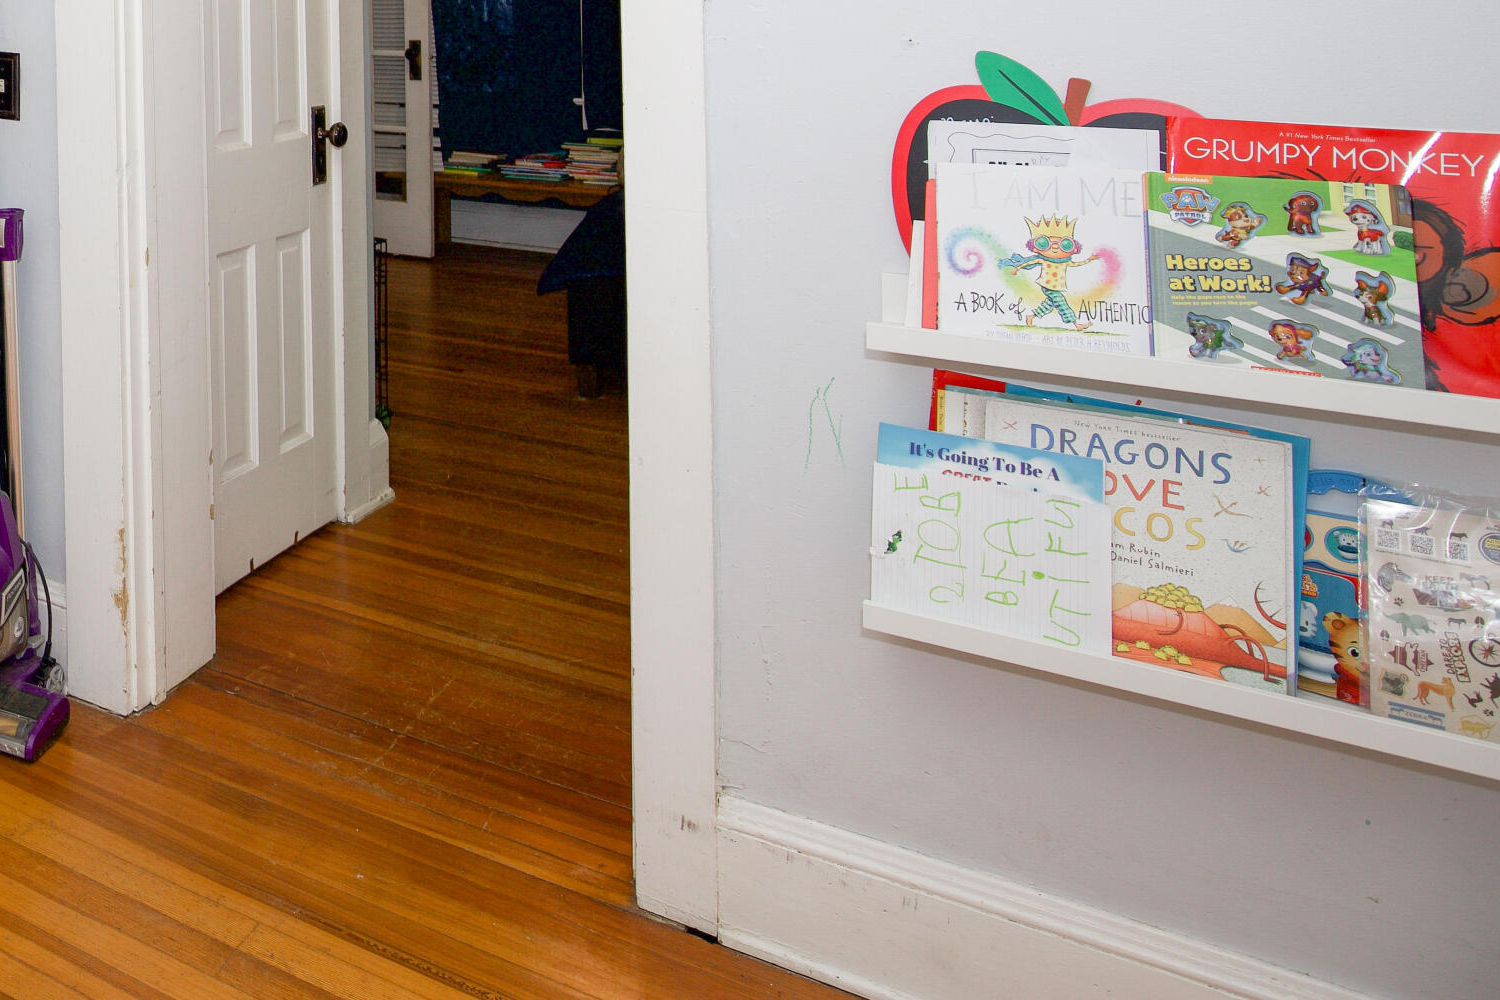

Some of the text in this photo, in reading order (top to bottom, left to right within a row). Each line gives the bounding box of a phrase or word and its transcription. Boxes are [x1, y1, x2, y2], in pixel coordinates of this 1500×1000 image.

[1345, 135, 1376, 143] Bestseller
[1184, 136, 1485, 177] GRUMPY MONKEY
[1003, 175, 1060, 211] AM
[1079, 177, 1142, 218] ME
[1160, 192, 1220, 212] PAW
[1165, 254, 1252, 271] Heroes
[1169, 274, 1272, 293] at Work!
[954, 292, 967, 312] A
[970, 291, 1005, 314] BOOK
[1008, 297, 1027, 321] of
[1074, 420, 1090, 428] New
[1115, 426, 1137, 435] Times
[1141, 431, 1181, 442] bestseller
[909, 441, 1061, 482] It's Going To Be A
[1030, 423, 1233, 485] DRAGONS
[1105, 470, 1185, 511] OVE
[1114, 507, 1206, 551] COS
[1111, 550, 1194, 577] Daniel Salmieri
[1129, 542, 1161, 558] Rubin
[1439, 637, 1456, 675] DARE TO
[1445, 631, 1471, 683] EXPLORE
